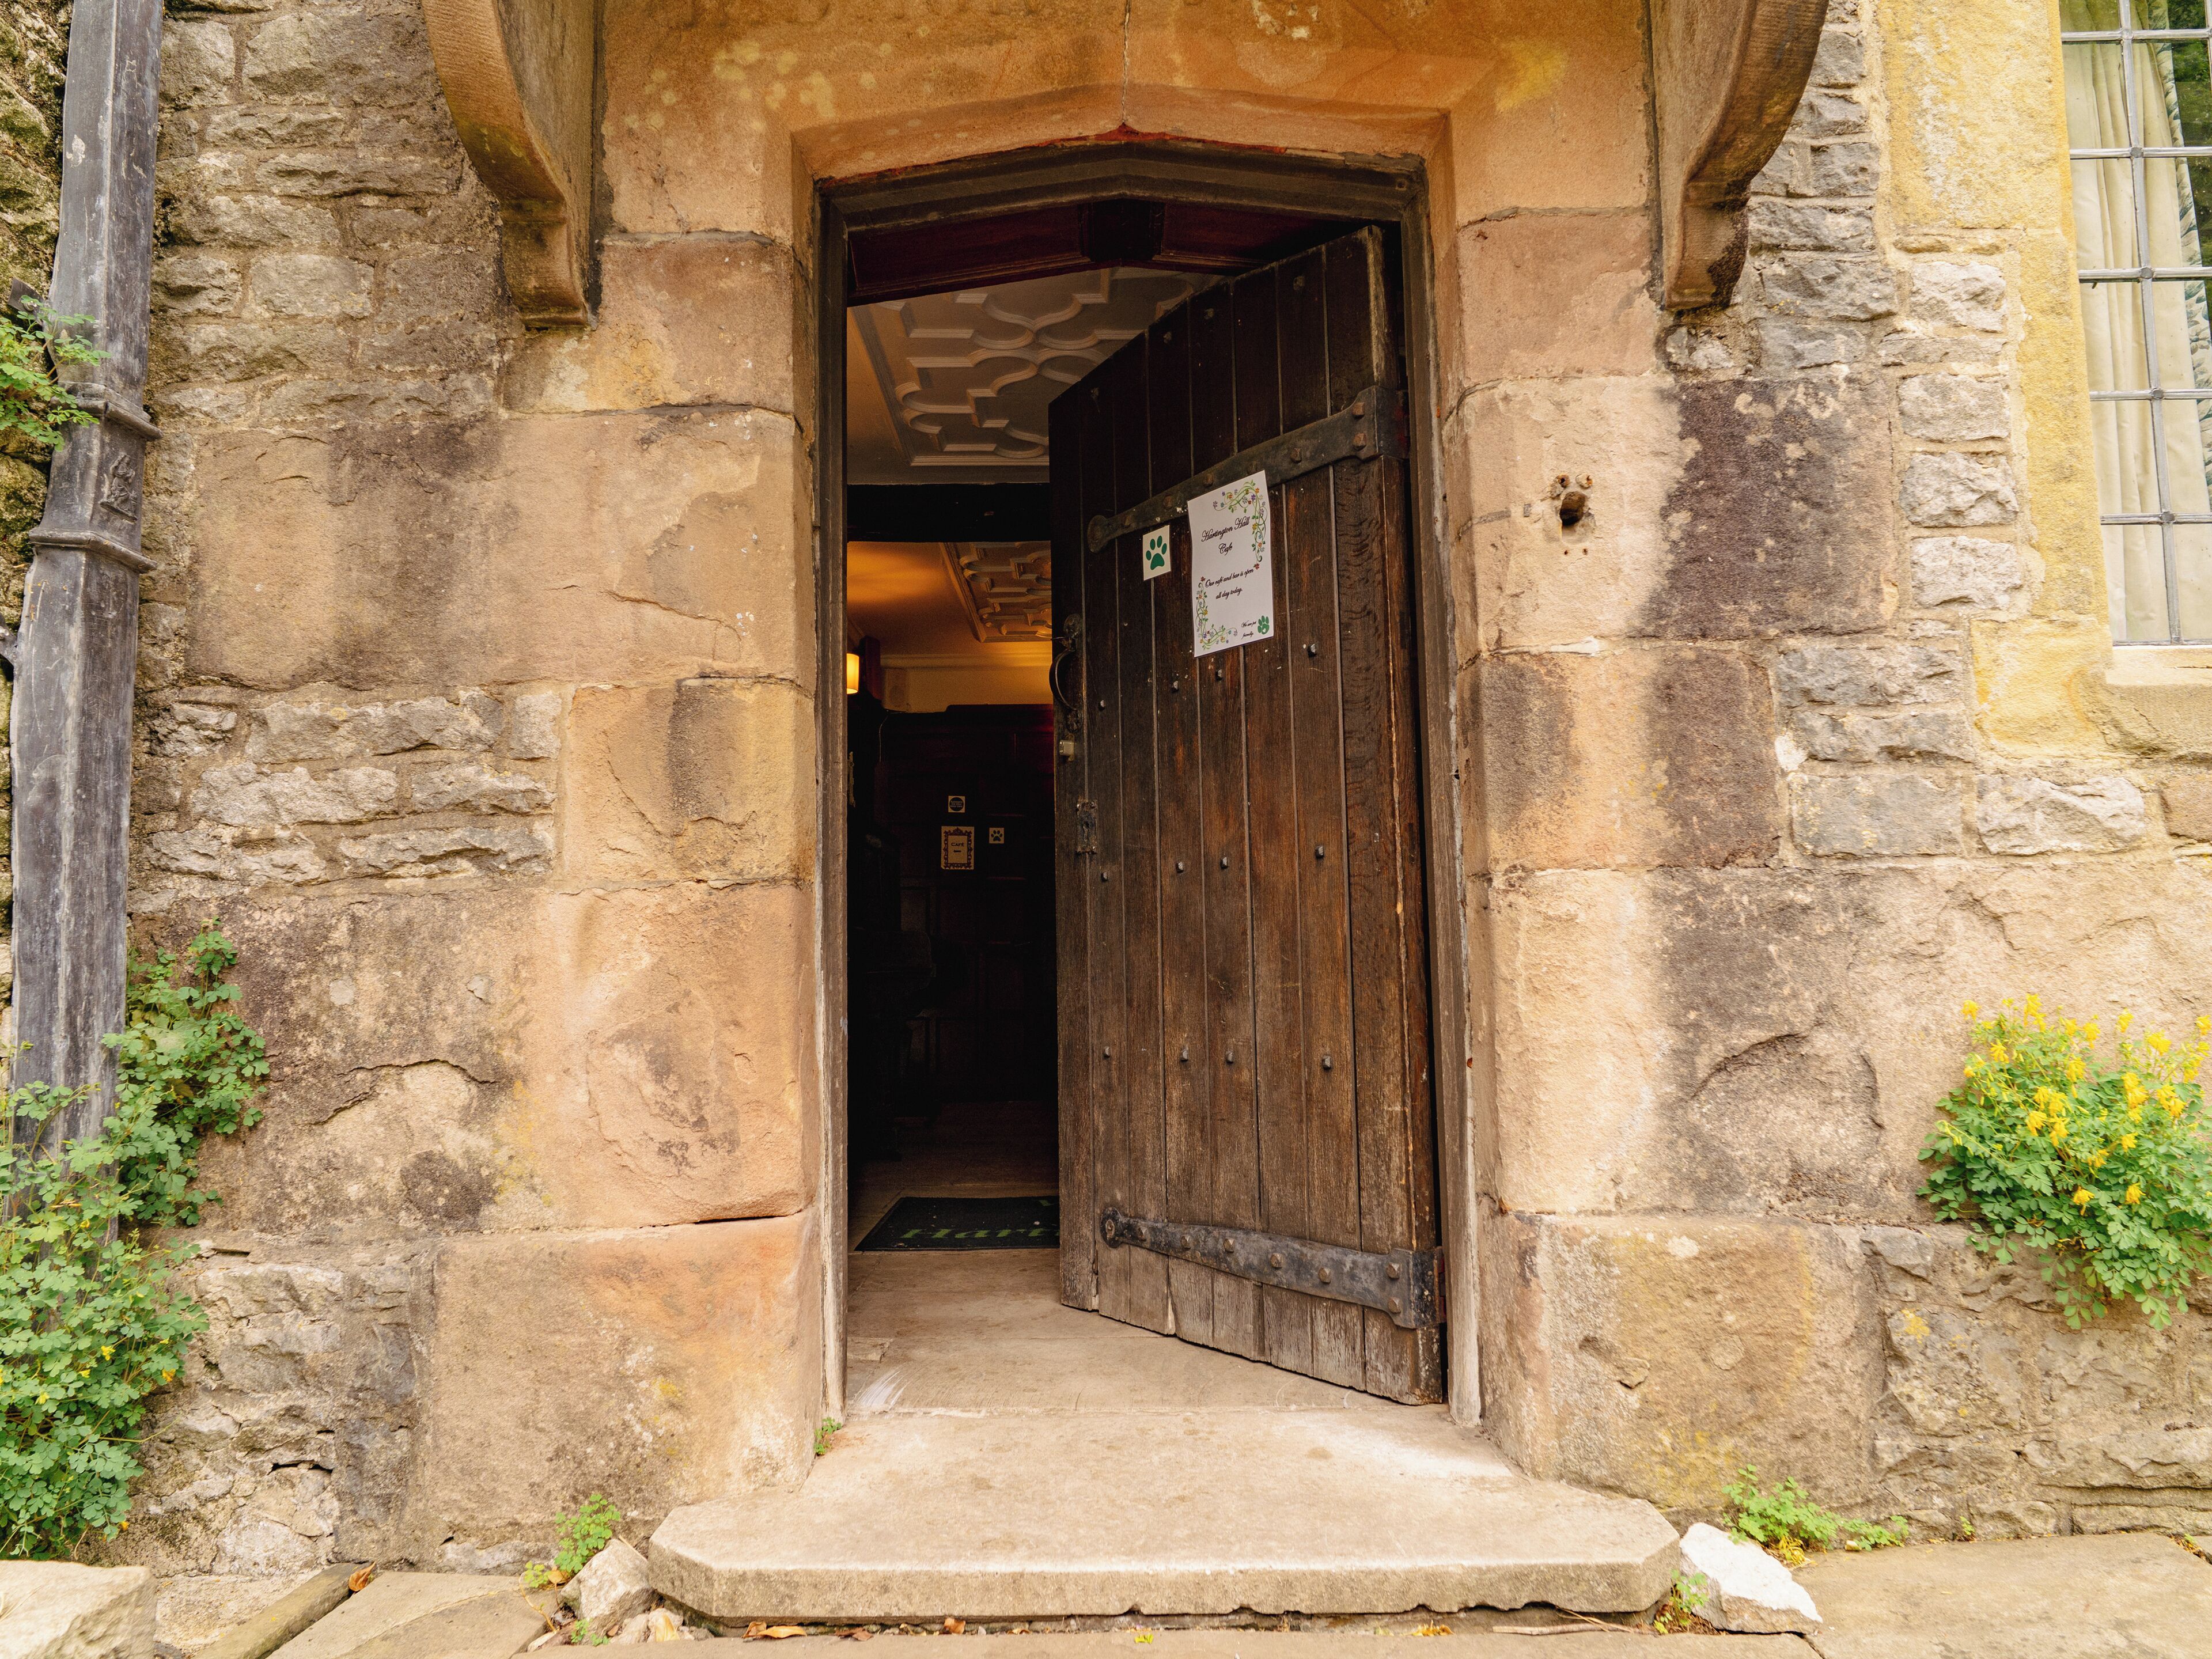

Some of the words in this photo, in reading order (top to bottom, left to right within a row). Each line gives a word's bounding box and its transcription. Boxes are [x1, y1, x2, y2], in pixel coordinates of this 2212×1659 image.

[1201, 527, 1233, 542] Hartington
[1234, 516, 1250, 530] Hall
[1205, 579, 1214, 588] Our
[1224, 573, 1233, 582] and
[1244, 569, 1254, 578] open
[1222, 590, 1230, 600] day
[1230, 586, 1243, 596] today.
[900, 1228, 1060, 1239] Hart
